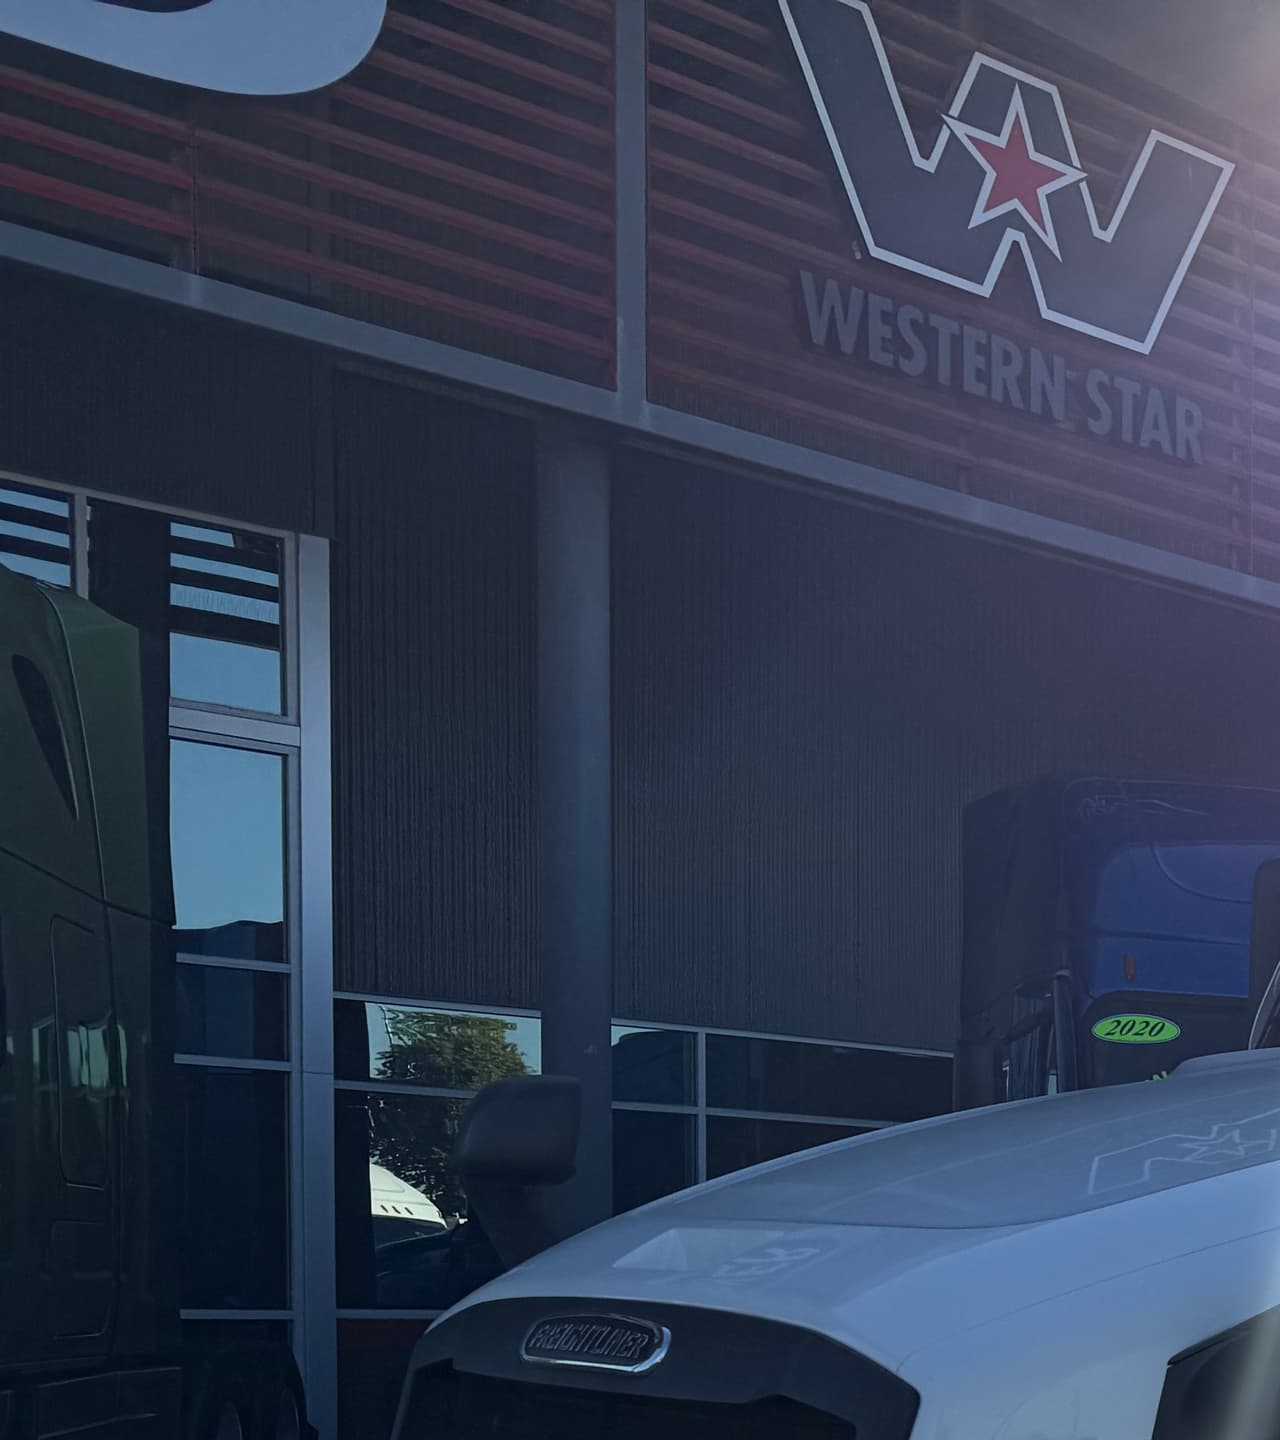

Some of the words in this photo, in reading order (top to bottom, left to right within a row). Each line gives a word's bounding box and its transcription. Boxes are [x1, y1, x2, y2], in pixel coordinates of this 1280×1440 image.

[800, 269, 1066, 432] WESTERN
[1084, 368, 1203, 465] STAR
[1104, 1019, 1166, 1038] 2020
[527, 1322, 650, 1360] FREIGHTLINER
